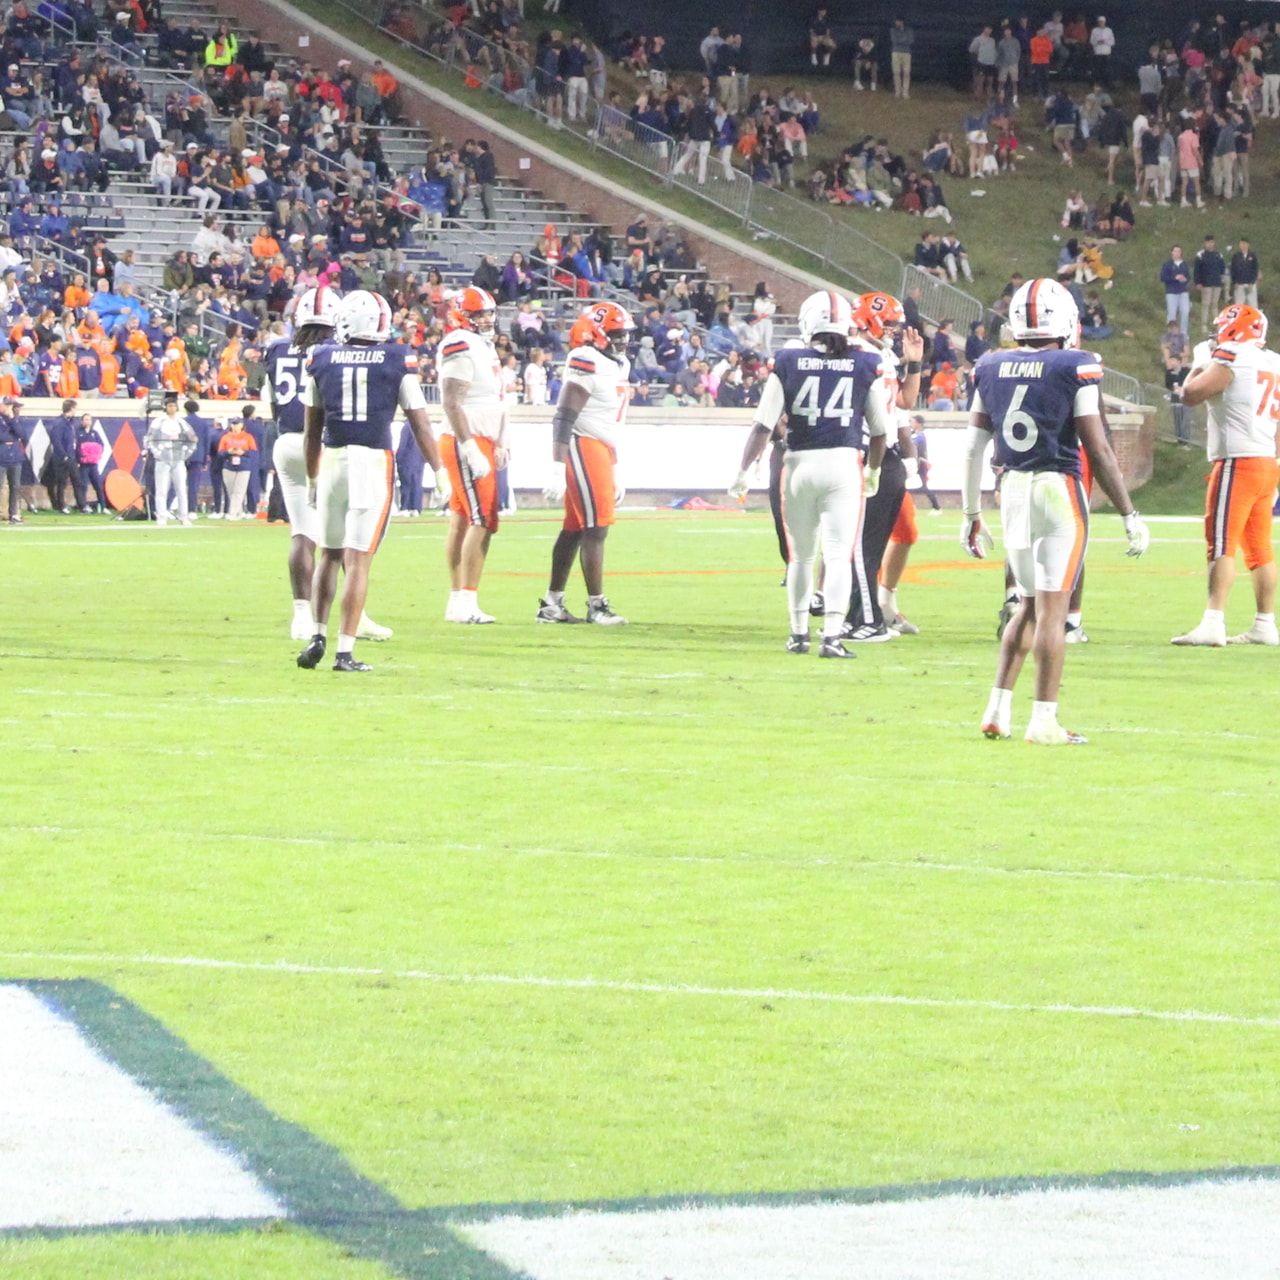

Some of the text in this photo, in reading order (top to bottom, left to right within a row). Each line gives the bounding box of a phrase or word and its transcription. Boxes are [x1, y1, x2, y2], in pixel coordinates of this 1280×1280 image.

[331, 350, 386, 364] MARCELLUS
[998, 361, 1045, 379] HILLMAN
[341, 367, 369, 422] 11
[791, 375, 855, 427] 44
[1002, 384, 1039, 453] 6
